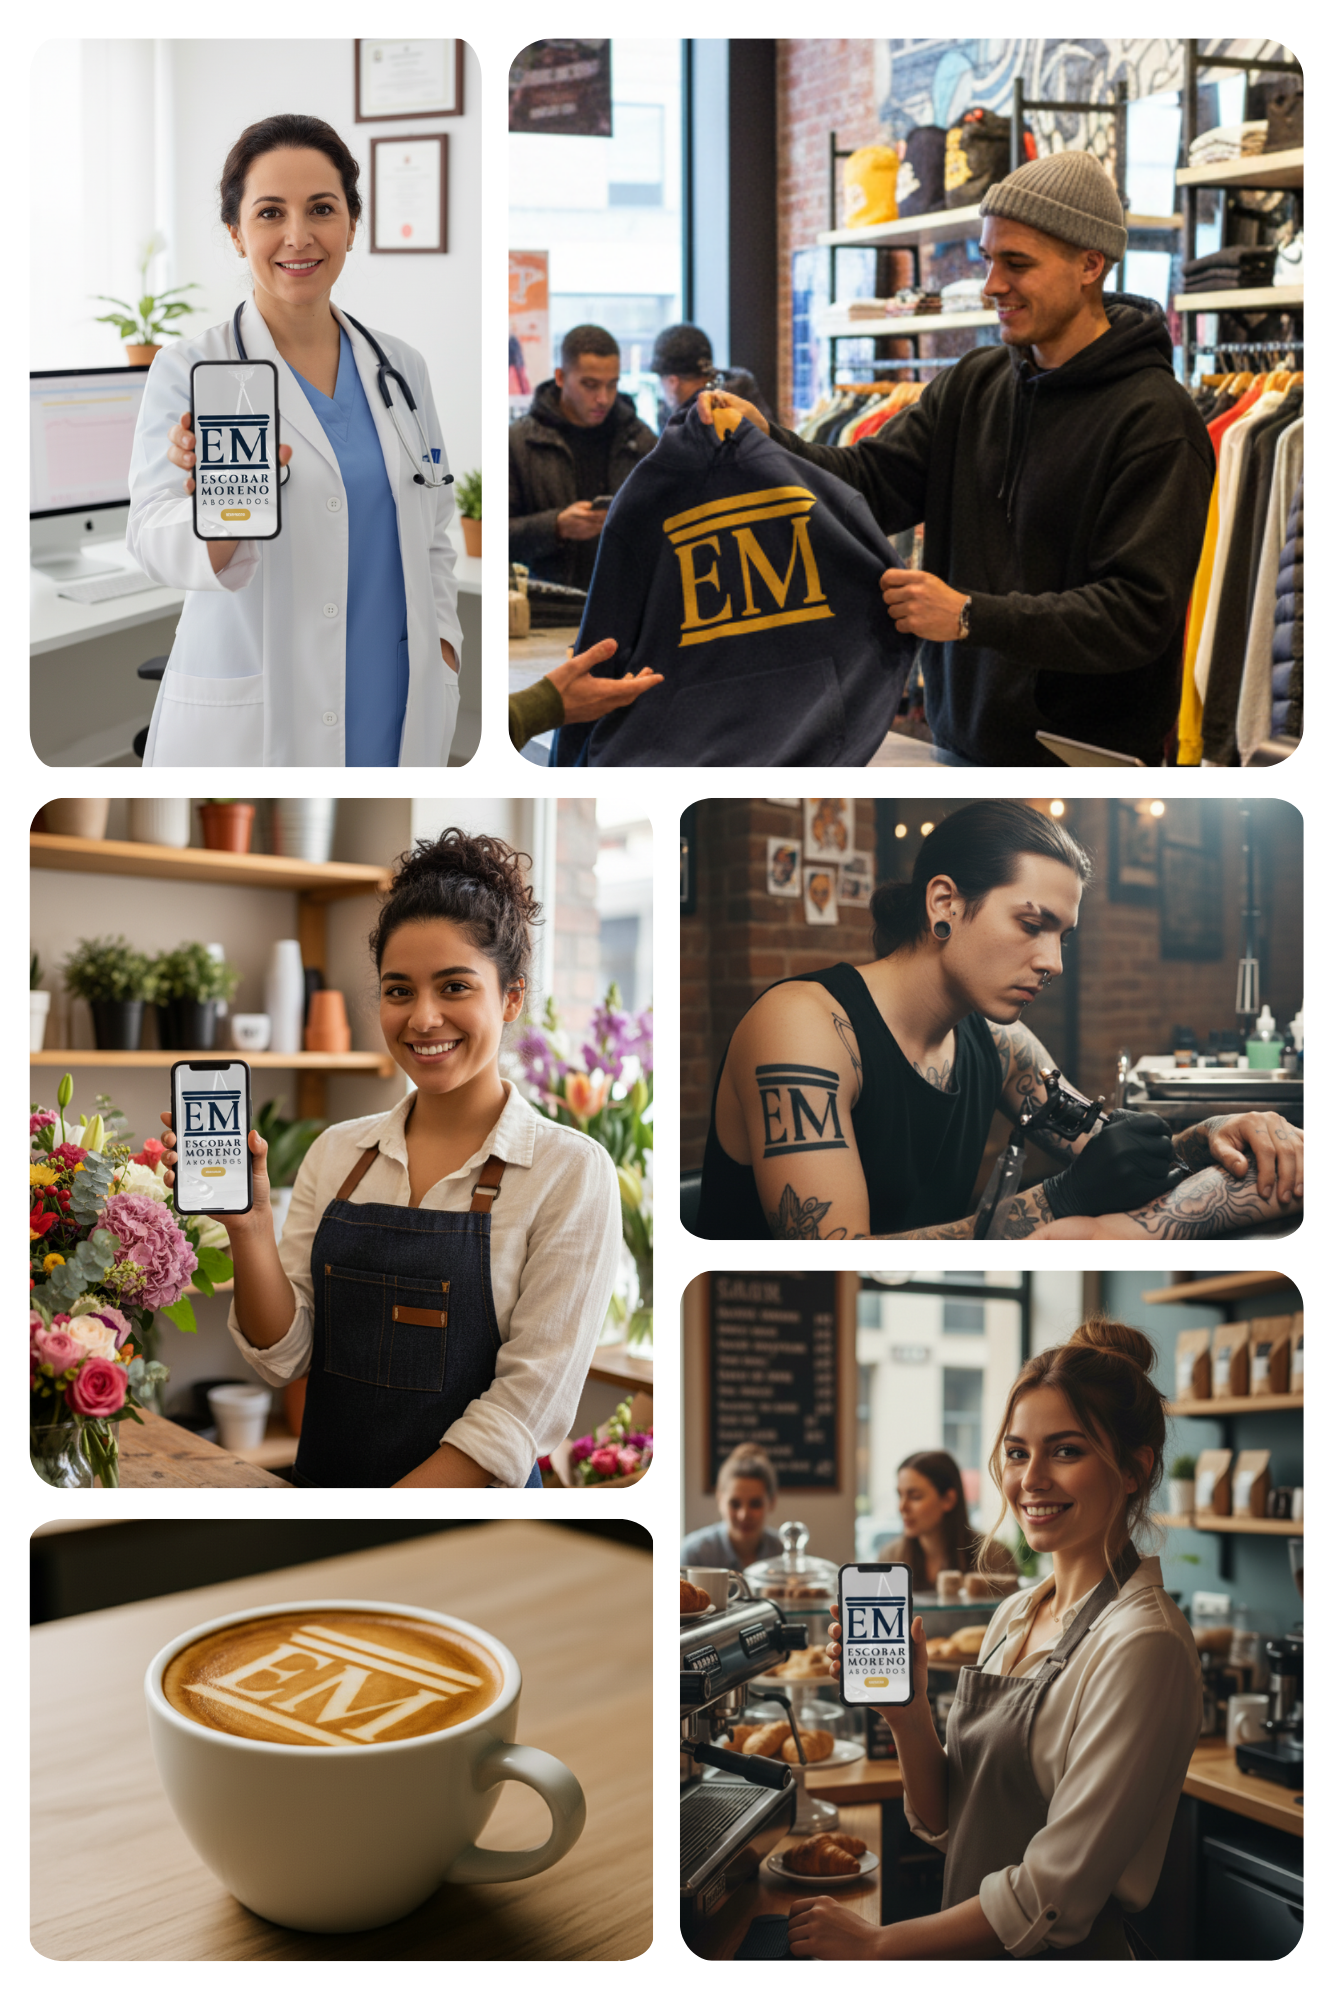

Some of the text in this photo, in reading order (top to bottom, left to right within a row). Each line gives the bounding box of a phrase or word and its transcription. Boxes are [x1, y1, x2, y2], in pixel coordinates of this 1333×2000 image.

[200, 427, 269, 463] EM
[200, 473, 269, 485] ESCOBAR
[201, 485, 269, 496] MORENO
[202, 497, 269, 506] ABOGADOS
[674, 515, 827, 630] EM
[184, 1100, 240, 1132] EM
[759, 1087, 844, 1146] EM
[185, 1139, 242, 1148] ESCOBAR
[185, 1147, 242, 1157] MORENO
[847, 1607, 905, 1639] EM
[847, 1647, 906, 1657] ESCOBAR
[847, 1657, 906, 1667] MORENO
[210, 1643, 449, 1742] EM
